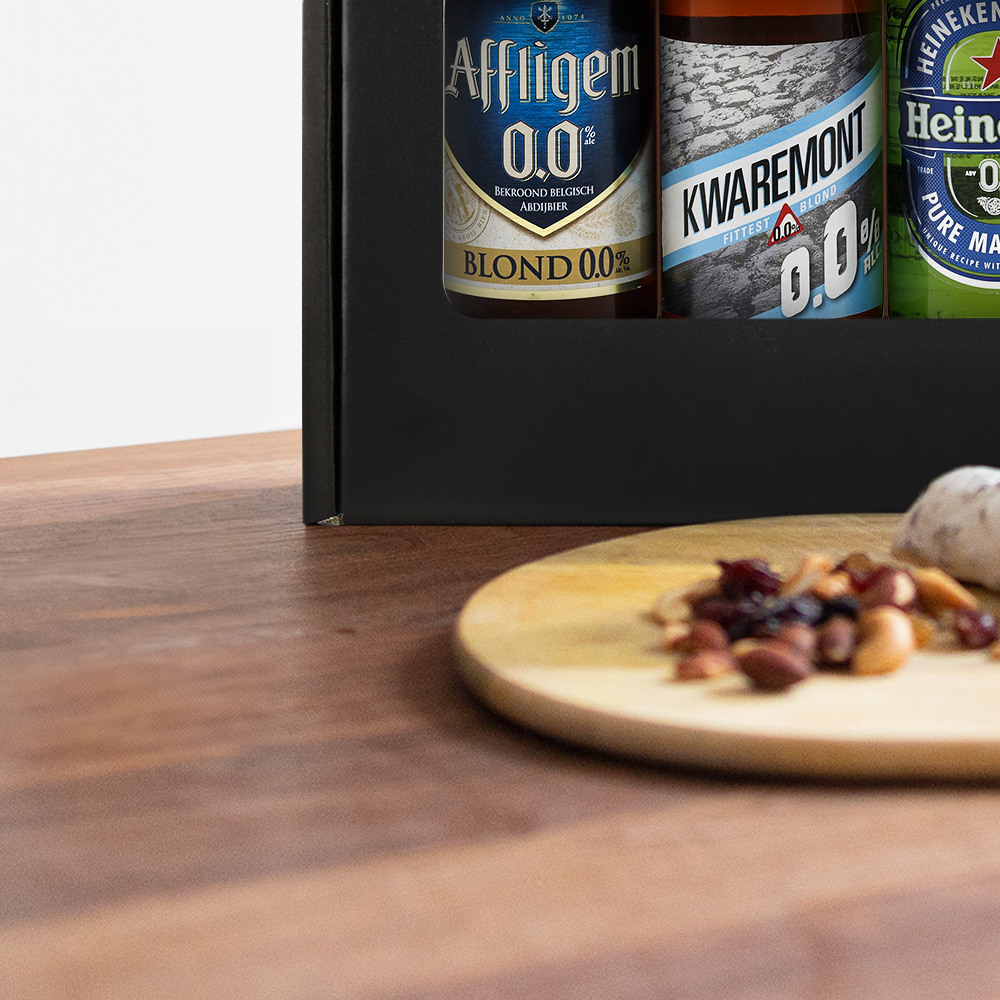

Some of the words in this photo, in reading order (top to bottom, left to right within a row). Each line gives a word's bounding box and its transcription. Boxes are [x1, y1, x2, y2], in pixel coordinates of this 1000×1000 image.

[500, 14, 526, 22] ANNO
[561, 13, 585, 21] 1074
[445, 36, 641, 117] Affligem
[683, 100, 866, 239] KWAREMONT
[917, 165, 934, 175] TRADE
[550, 185, 594, 197] BELGISCH
[723, 216, 770, 246] FITTEST
[799, 184, 838, 213] BLOND
[921, 191, 965, 244] PURE
[463, 250, 573, 281] BLOND
[922, 227, 947, 255] UNIQUE
[949, 252, 980, 268] RECIPE
